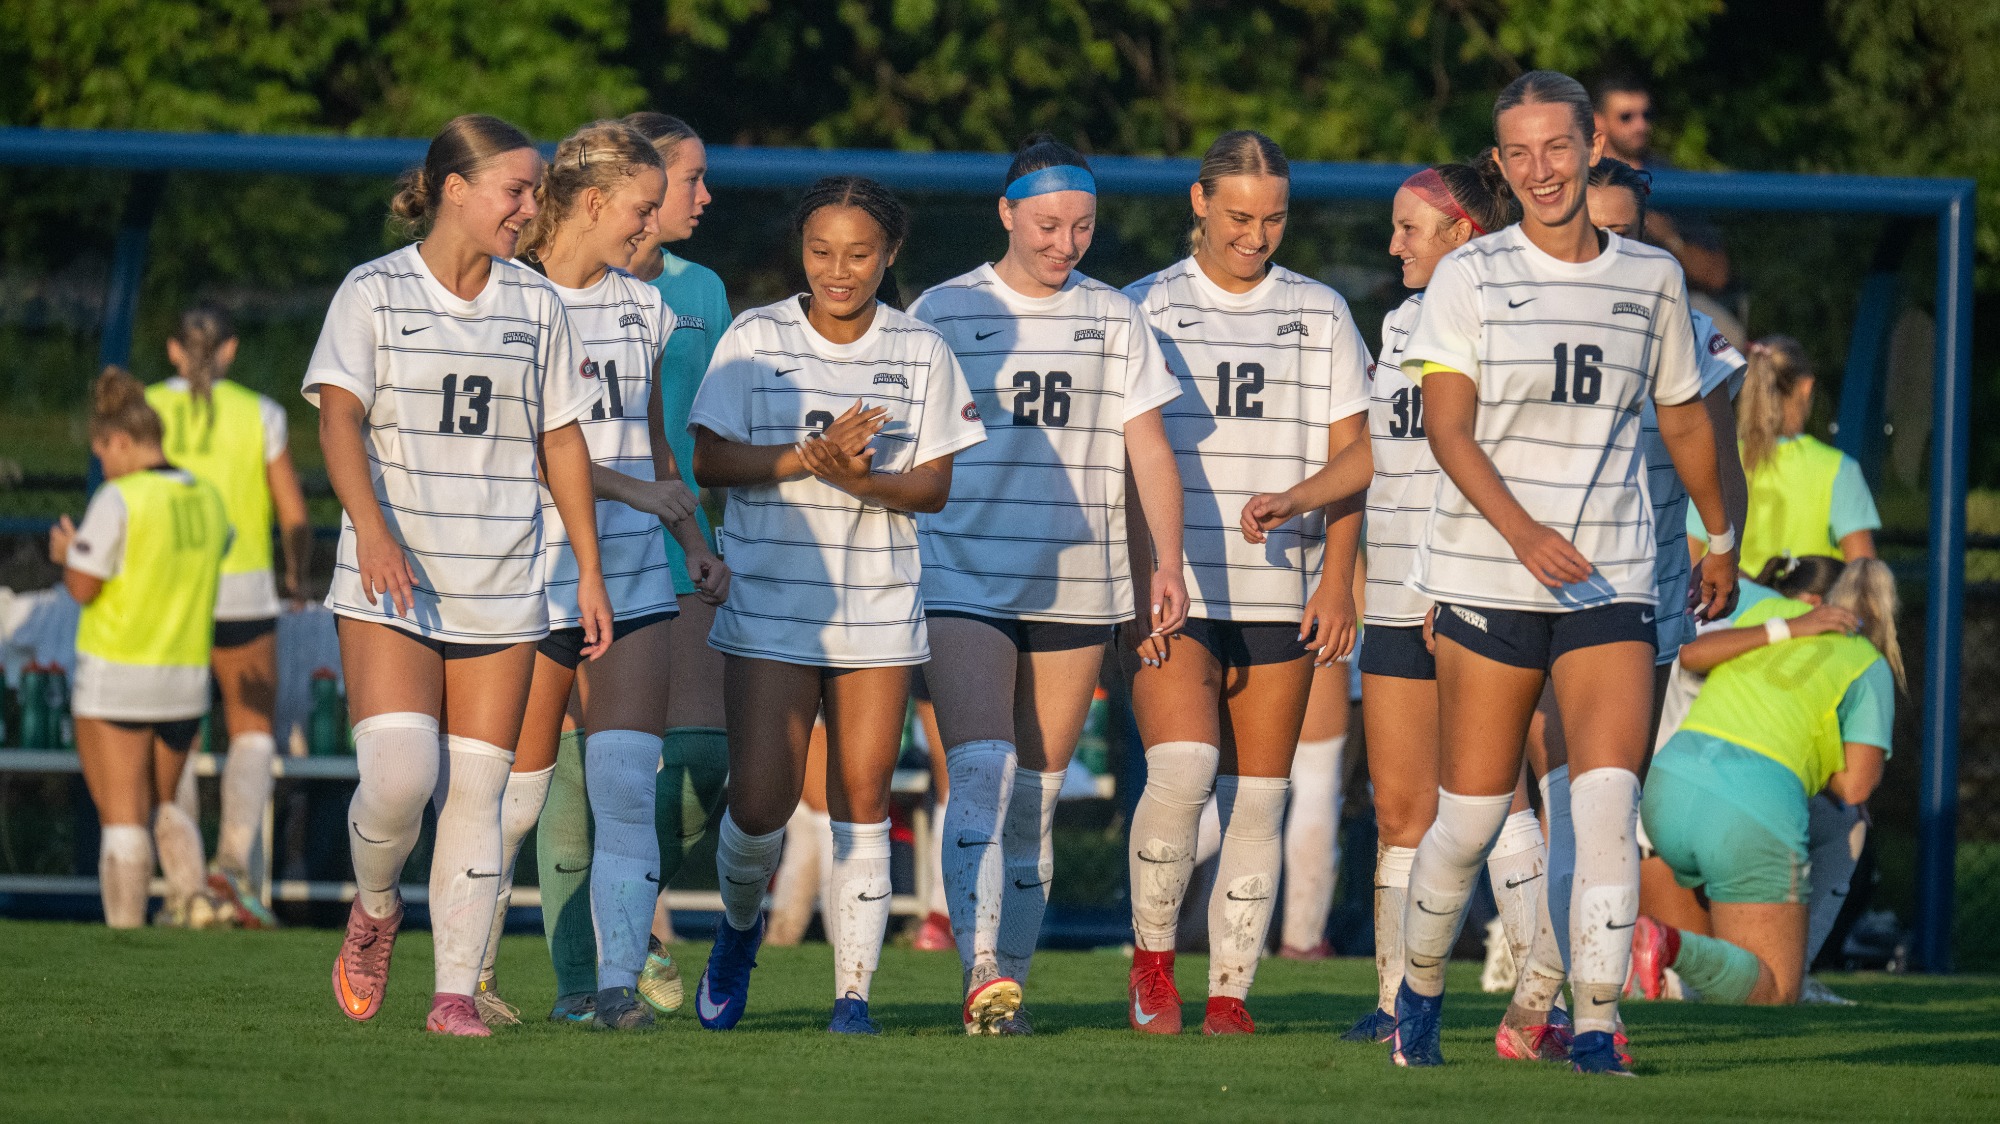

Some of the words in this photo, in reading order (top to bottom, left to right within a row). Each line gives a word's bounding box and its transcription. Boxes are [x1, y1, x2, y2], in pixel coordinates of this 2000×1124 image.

[1013, 371, 1072, 427] 26
[1216, 362, 1264, 418] 12
[1551, 343, 1603, 404] 16
[439, 374, 492, 435] 13
